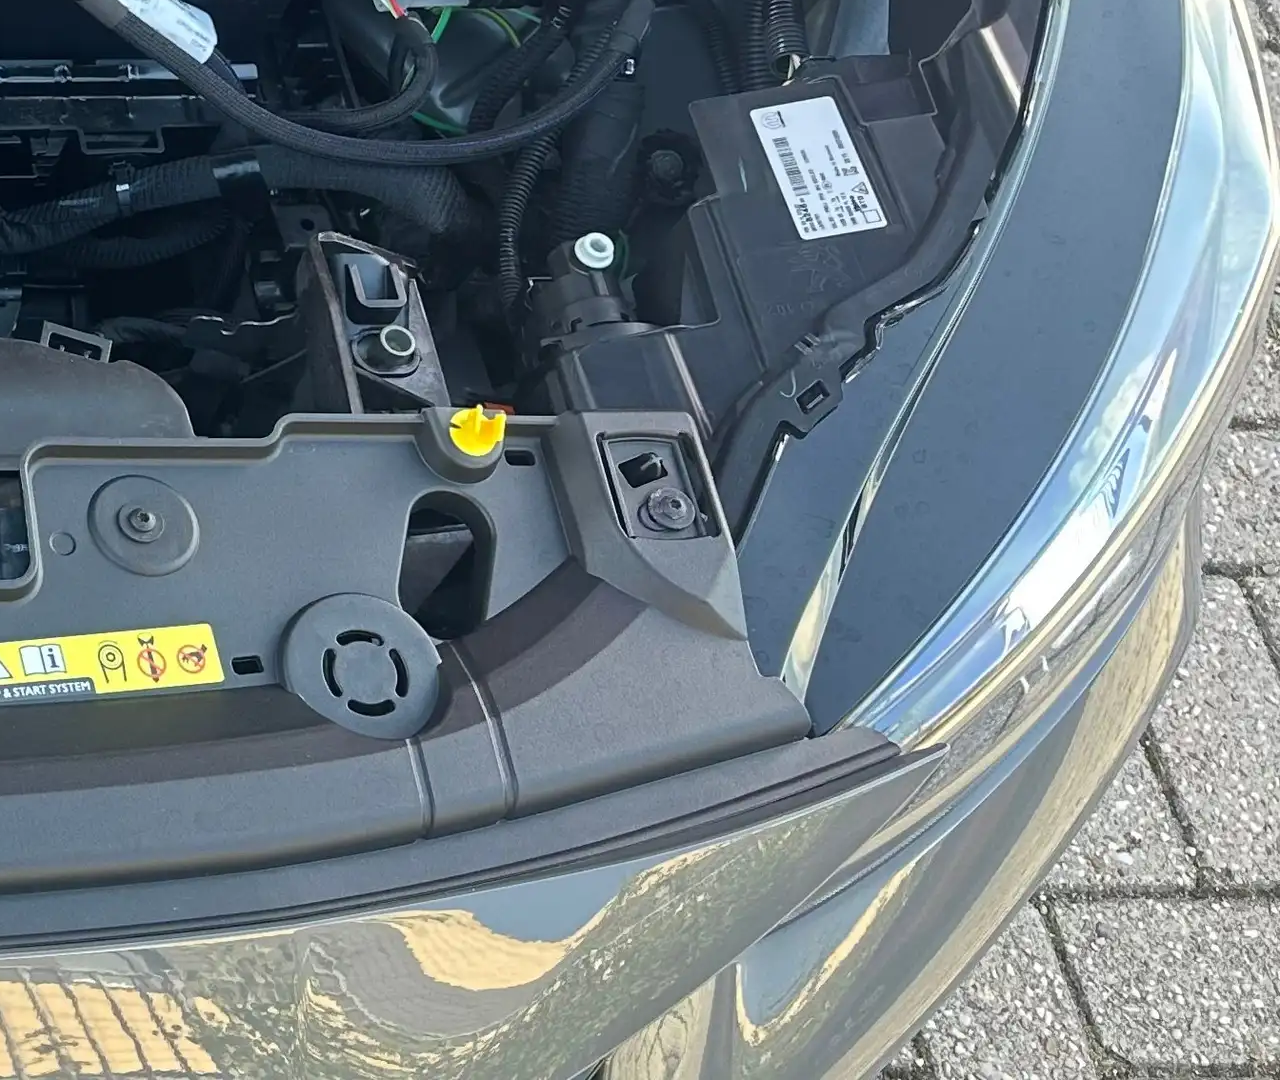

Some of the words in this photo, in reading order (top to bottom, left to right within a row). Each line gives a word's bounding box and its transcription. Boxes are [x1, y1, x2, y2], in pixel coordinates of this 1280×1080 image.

[3, 687, 12, 699] &
[12, 684, 47, 698] START
[48, 680, 91, 695] SYSTEM
